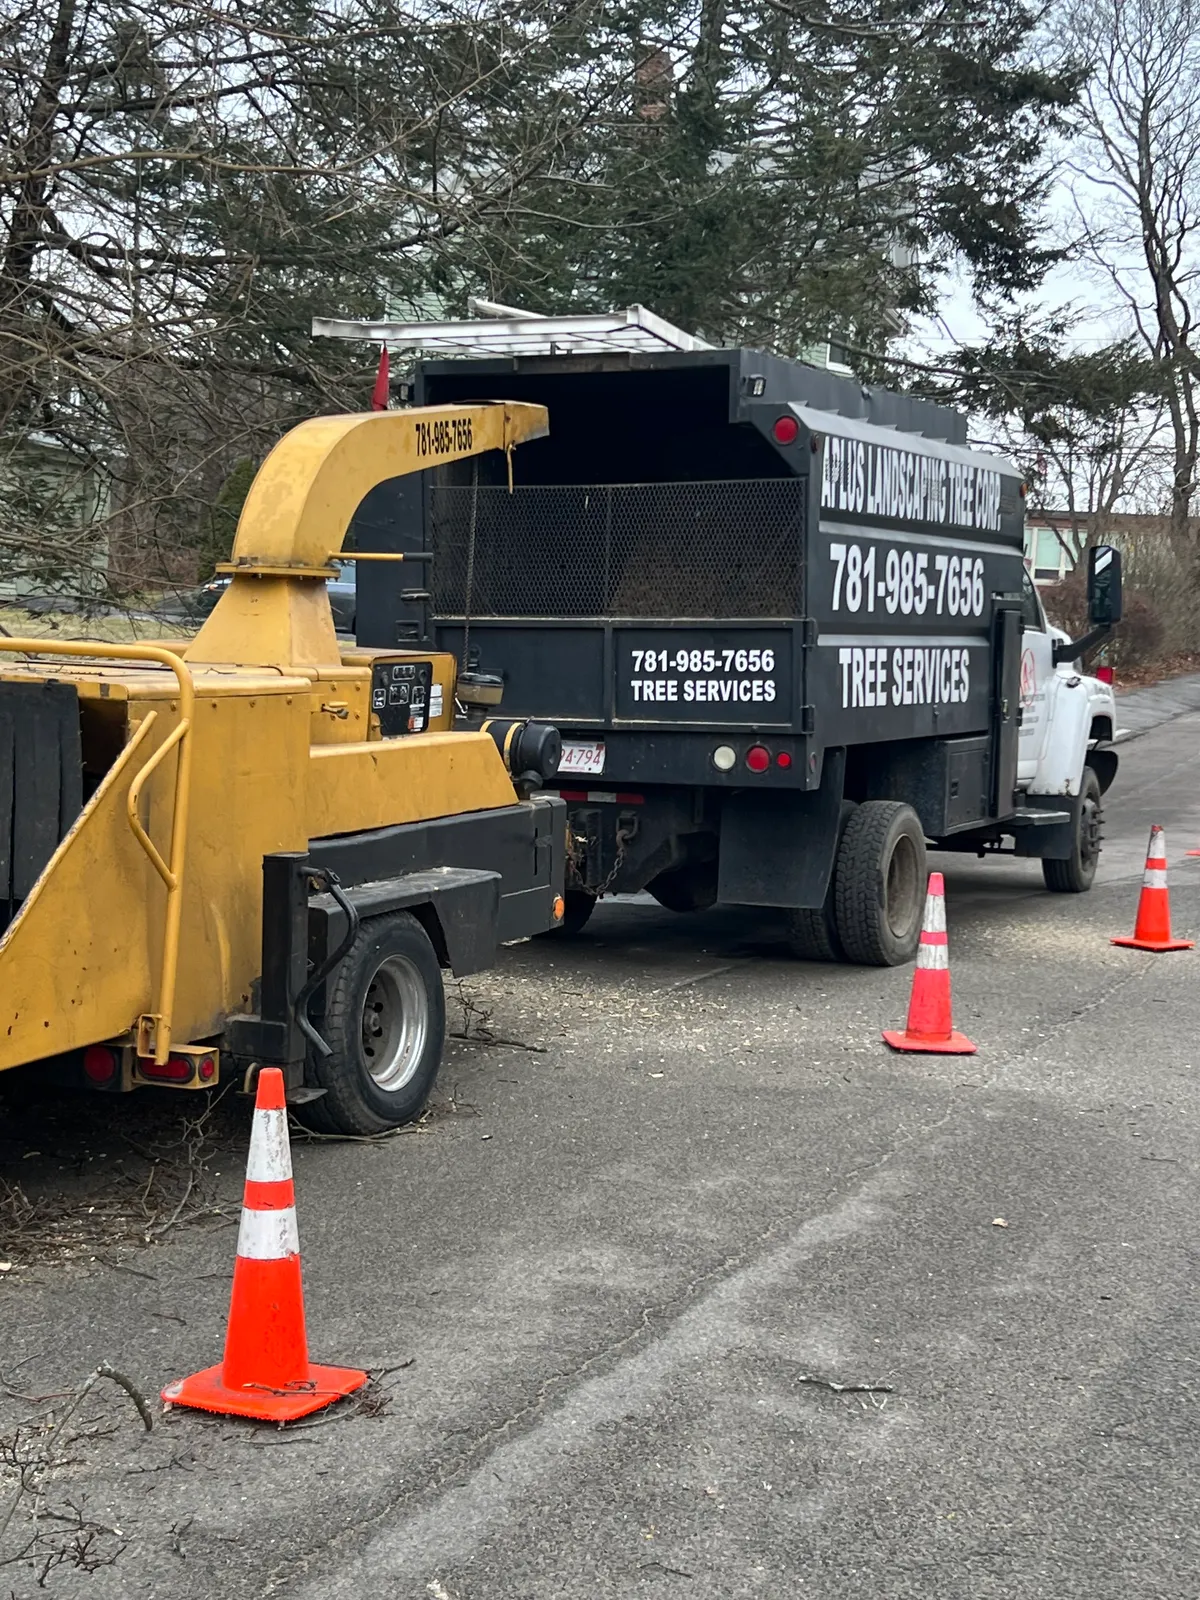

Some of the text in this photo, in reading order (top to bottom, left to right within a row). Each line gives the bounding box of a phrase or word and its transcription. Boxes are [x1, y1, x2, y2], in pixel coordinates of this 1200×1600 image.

[415, 417, 472, 457] 781-985-7656
[866, 445, 946, 524] LANDSCAPING
[949, 462, 975, 526] TREE
[975, 468, 1001, 532] CORP.
[829, 542, 985, 617] 781-985-7656
[631, 649, 775, 672] 781-985-7656
[839, 647, 970, 708] TREE SERVICES
[630, 679, 776, 702] TREE SERVICES
